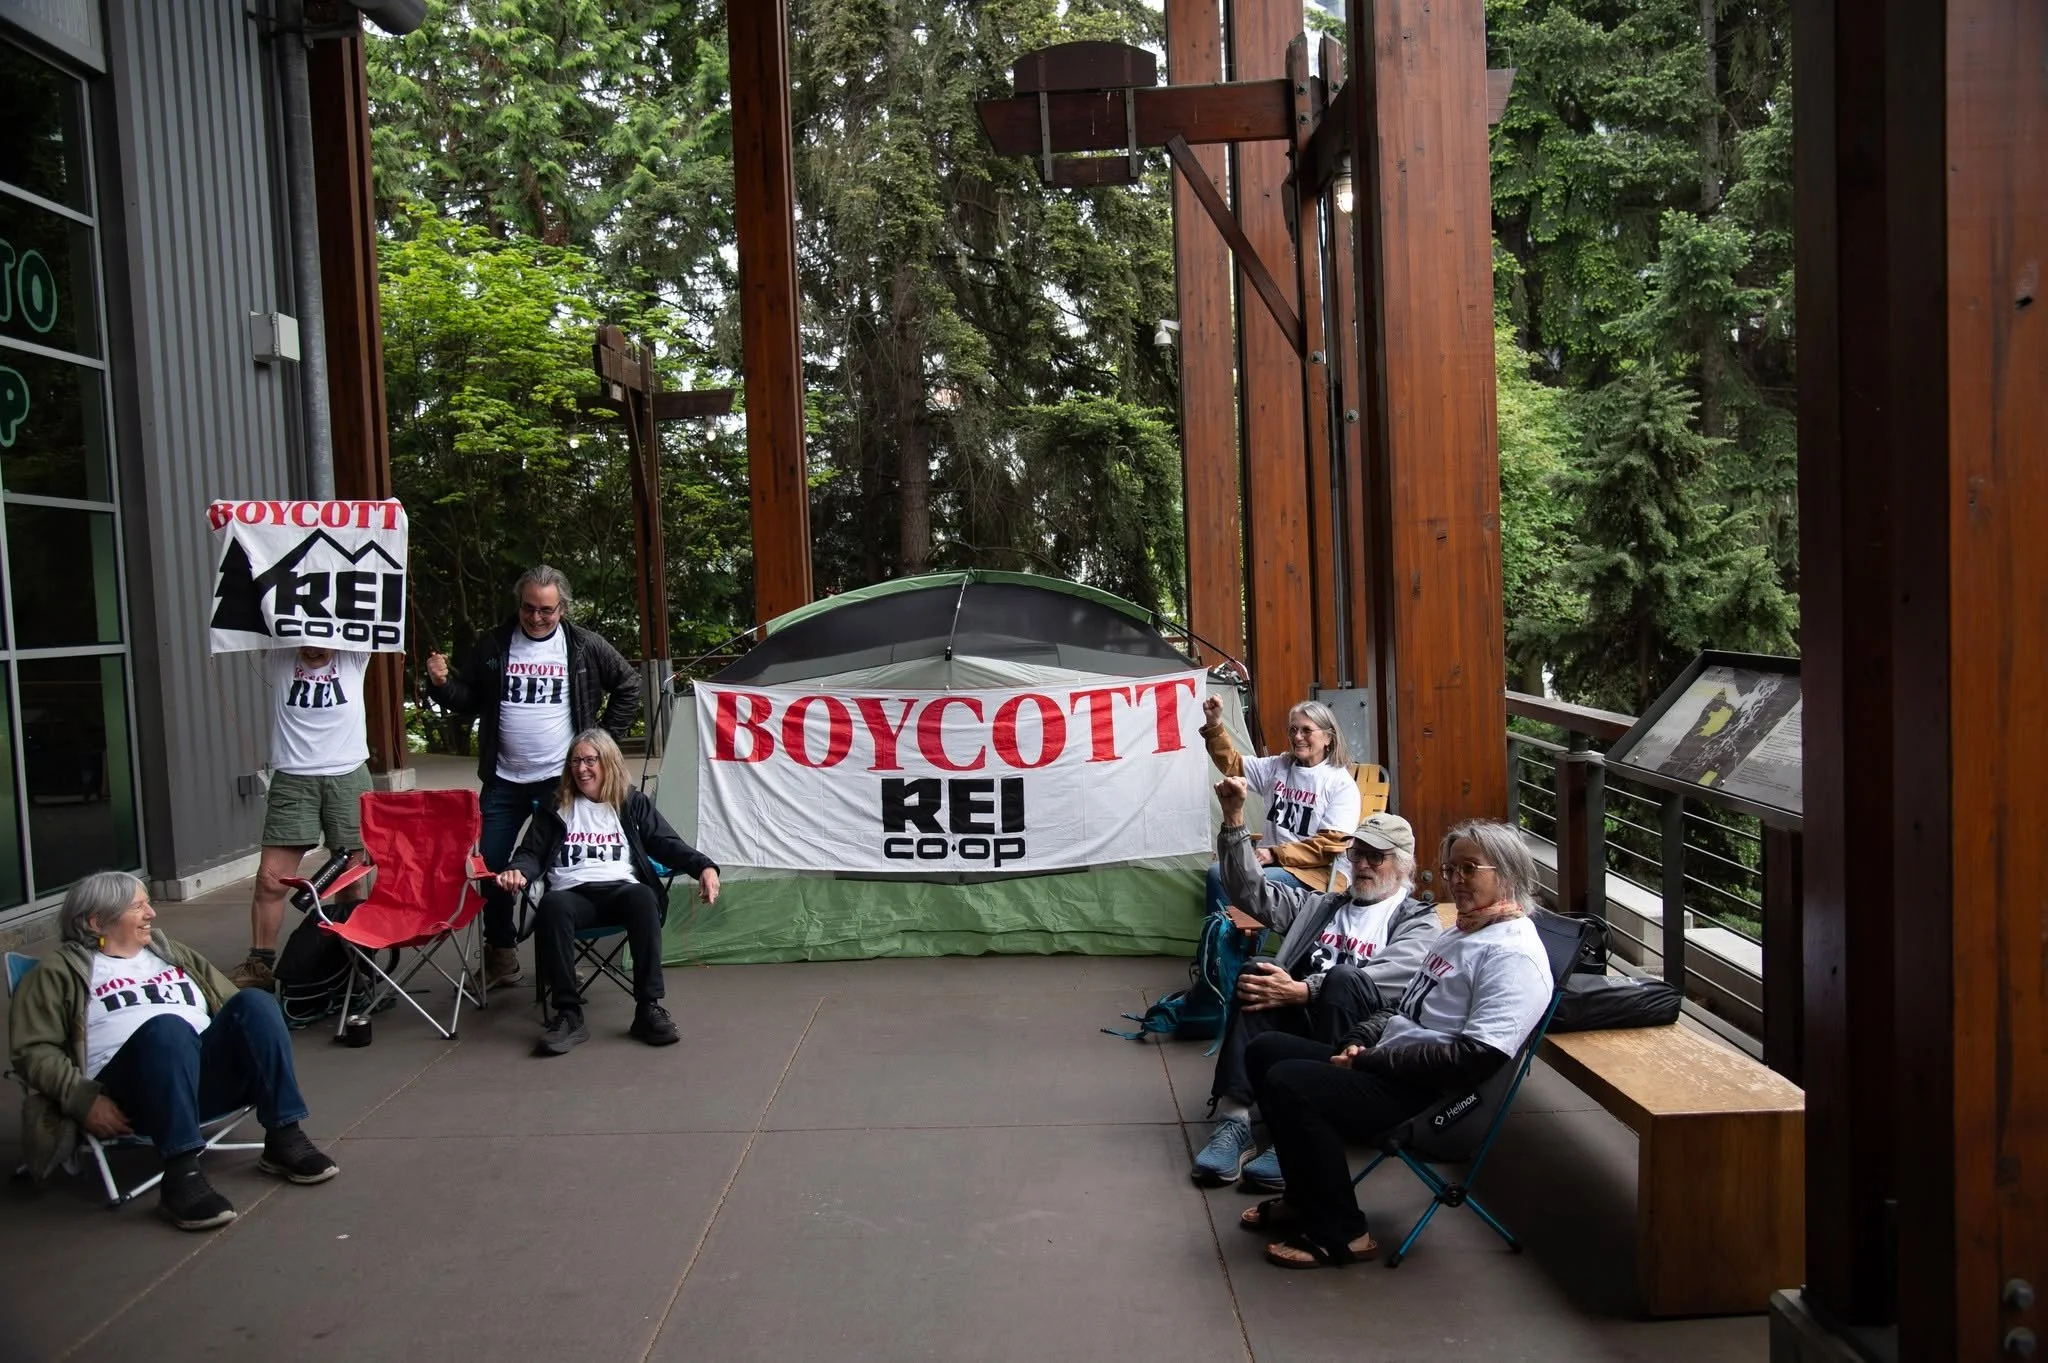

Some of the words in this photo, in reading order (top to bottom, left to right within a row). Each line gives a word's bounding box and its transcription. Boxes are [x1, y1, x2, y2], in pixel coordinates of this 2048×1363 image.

[208, 500, 403, 531] BOYCOTT
[274, 571, 403, 622] REI
[506, 663, 566, 677] OYCOTT
[286, 677, 348, 708] REI
[500, 676, 564, 704] REI
[708, 678, 1197, 771] BOYCOTT
[881, 777, 1025, 834] REI
[1267, 793, 1313, 836] REI
[557, 843, 623, 867] REI
[1316, 929, 1376, 957] OYOTT
[95, 966, 185, 997] BOYOTT
[100, 982, 196, 1012] REI
[1400, 970, 1439, 1023] EI
[1446, 1093, 1477, 1118] Helinox
